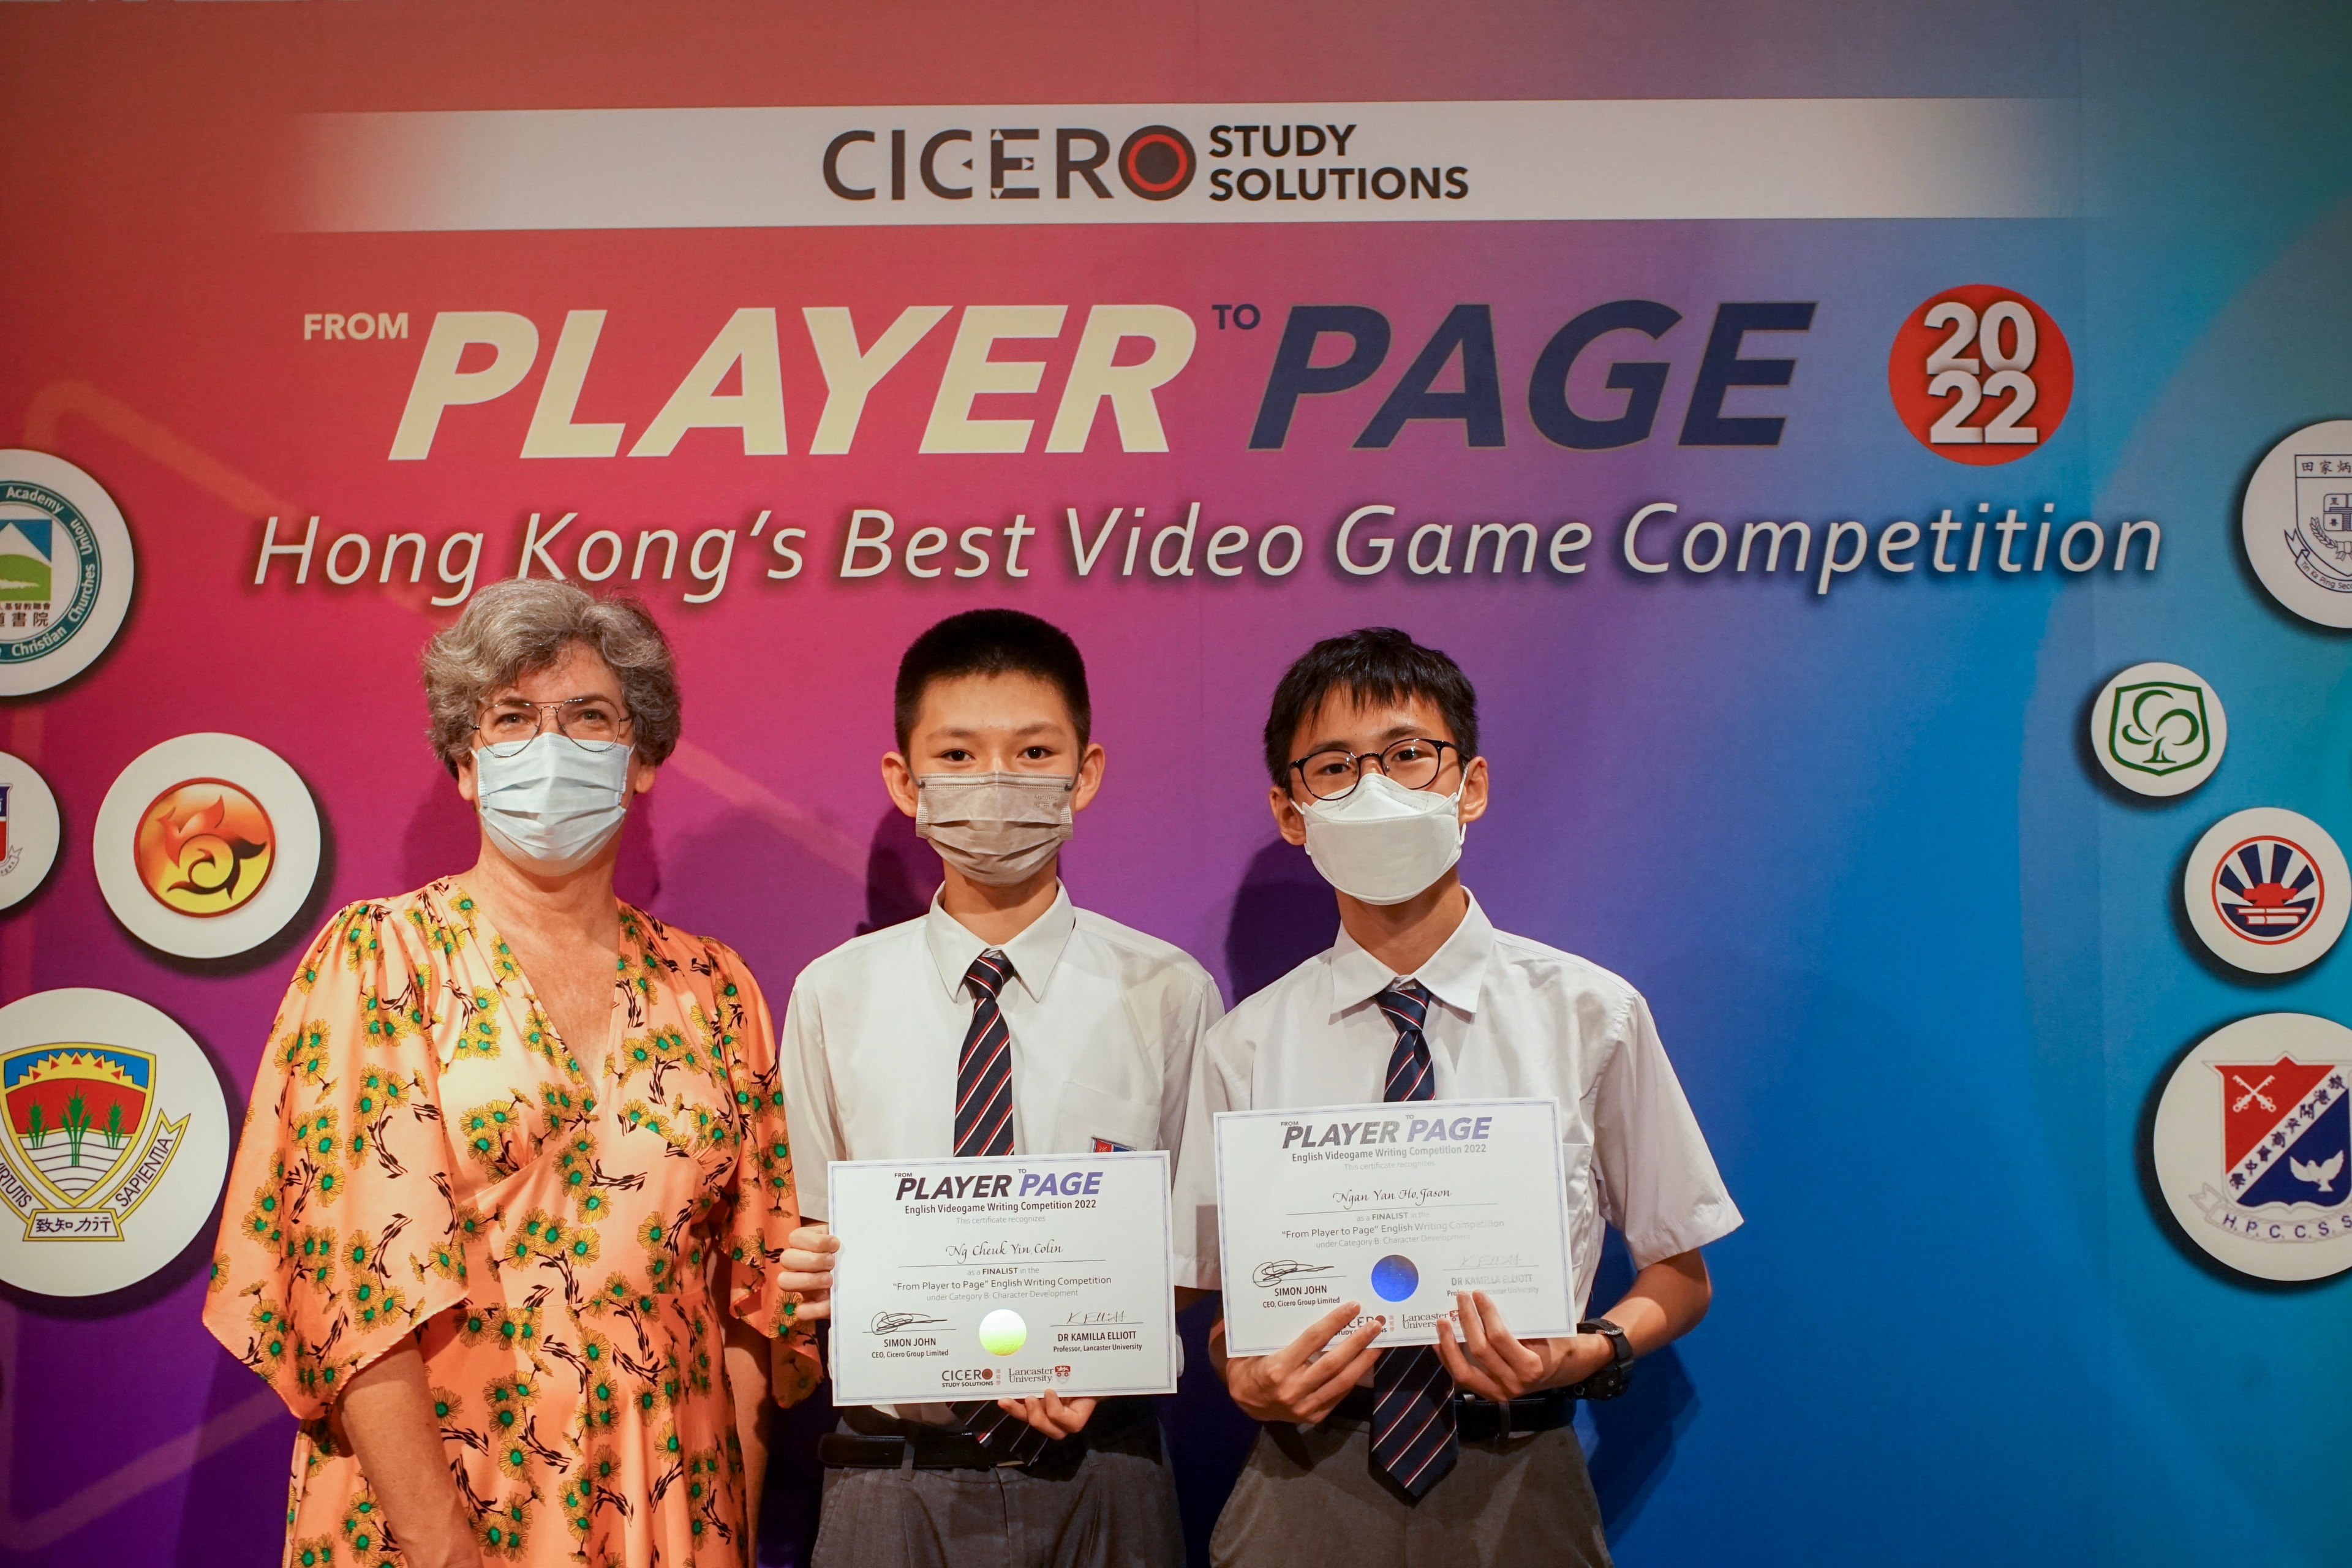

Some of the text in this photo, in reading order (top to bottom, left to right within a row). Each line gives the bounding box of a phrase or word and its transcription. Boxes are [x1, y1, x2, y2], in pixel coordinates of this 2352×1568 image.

[1208, 124, 1357, 158] STUDY
[823, 124, 1197, 202] CICERO
[1208, 166, 1469, 202] SOLUTIONS
[304, 299, 1819, 461] FROM PLAYER TO PAGE
[2302, 460, 2351, 474] 田家炳
[6, 486, 64, 514] Academy
[254, 516, 483, 606] Hong
[840, 510, 1037, 578] Best
[1066, 502, 1303, 578] Video
[1336, 503, 1593, 576] Game
[1623, 500, 2162, 595] Competition
[12, 519, 96, 657] Christian Churches Union
[2320, 576, 2335, 589] Ping
[1283, 1121, 1400, 1148] PLAYER
[1407, 1117, 1492, 1142] PAGE
[1292, 1144, 1487, 1164] English Videogame Writing Competition 2022
[0, 1139, 173, 1207] IRTUTIS SAPIENTIA
[895, 1175, 1012, 1200] PLAYER
[1019, 1172, 1103, 1196] PAGE
[905, 1199, 1096, 1216] English Videogame Writing Competition 2022
[1333, 1189, 1370, 1210] Ngan
[1373, 1189, 1396, 1200] Yan
[36, 1217, 111, 1232] 致知力行
[1312, 1229, 1339, 1238] Player
[1353, 1226, 1378, 1236] Page”
[1381, 1224, 1413, 1234] English
[1414, 1222, 1447, 1232] Writing
[1339, 1238, 1373, 1248] Category
[1383, 1235, 1419, 1244] Character
[1421, 1234, 1471, 1242] Development
[946, 1243, 967, 1264] Ng
[922, 1282, 949, 1291] Player
[963, 1280, 989, 1290] Page”
[992, 1279, 1022, 1289] English
[1024, 1278, 1056, 1287] Writing
[1058, 1276, 1111, 1286] Competition
[1275, 1285, 1327, 1296] SIMON JOHN
[949, 1293, 982, 1302] Category
[1030, 1289, 1078, 1298] Development
[1402, 1313, 1449, 1322] Lancaster
[1403, 1321, 1436, 1330] Univers
[884, 1338, 936, 1347] SIMON JOHN
[1072, 1332, 1106, 1341] KAMILLA
[1108, 1331, 1136, 1340] ELLIOTT
[942, 1368, 993, 1381] CICERO
